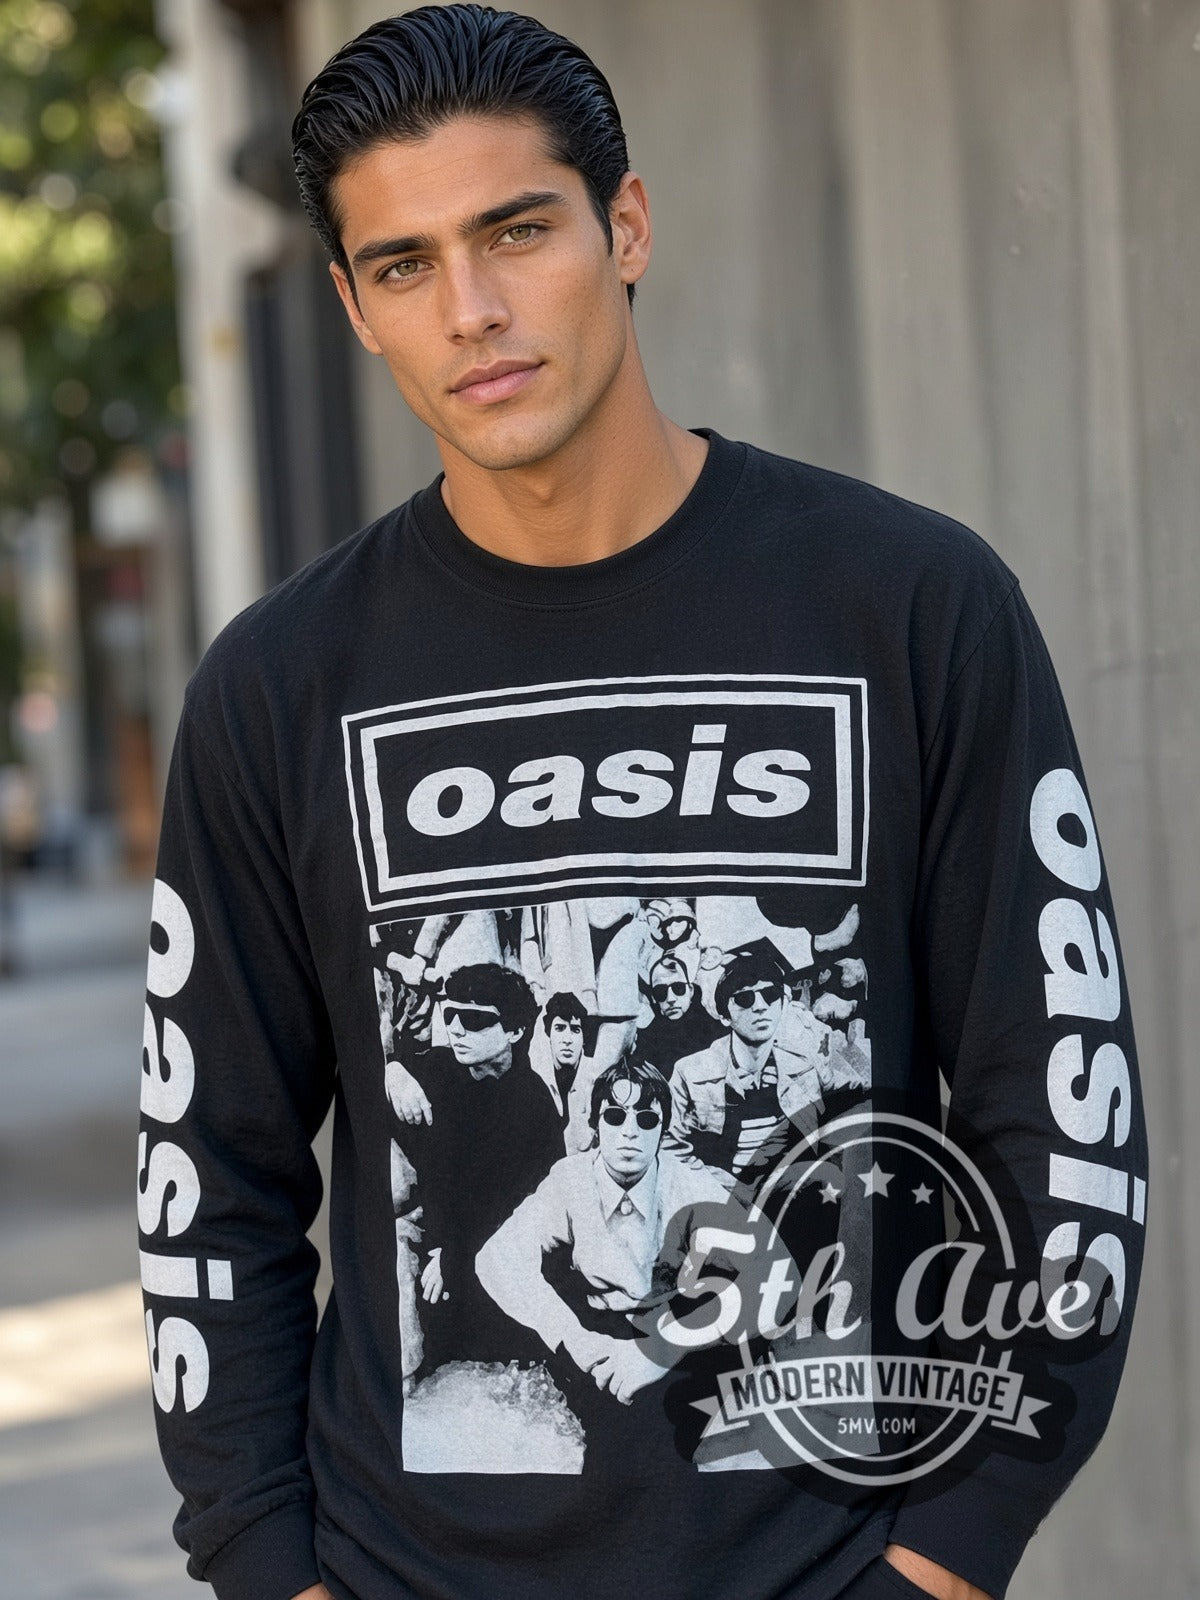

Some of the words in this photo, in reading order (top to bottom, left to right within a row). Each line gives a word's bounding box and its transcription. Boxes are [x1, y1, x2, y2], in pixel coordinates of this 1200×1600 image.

[406, 724, 811, 837] oasis
[137, 878, 234, 1415] oasis
[1029, 767, 1147, 1336] oasis
